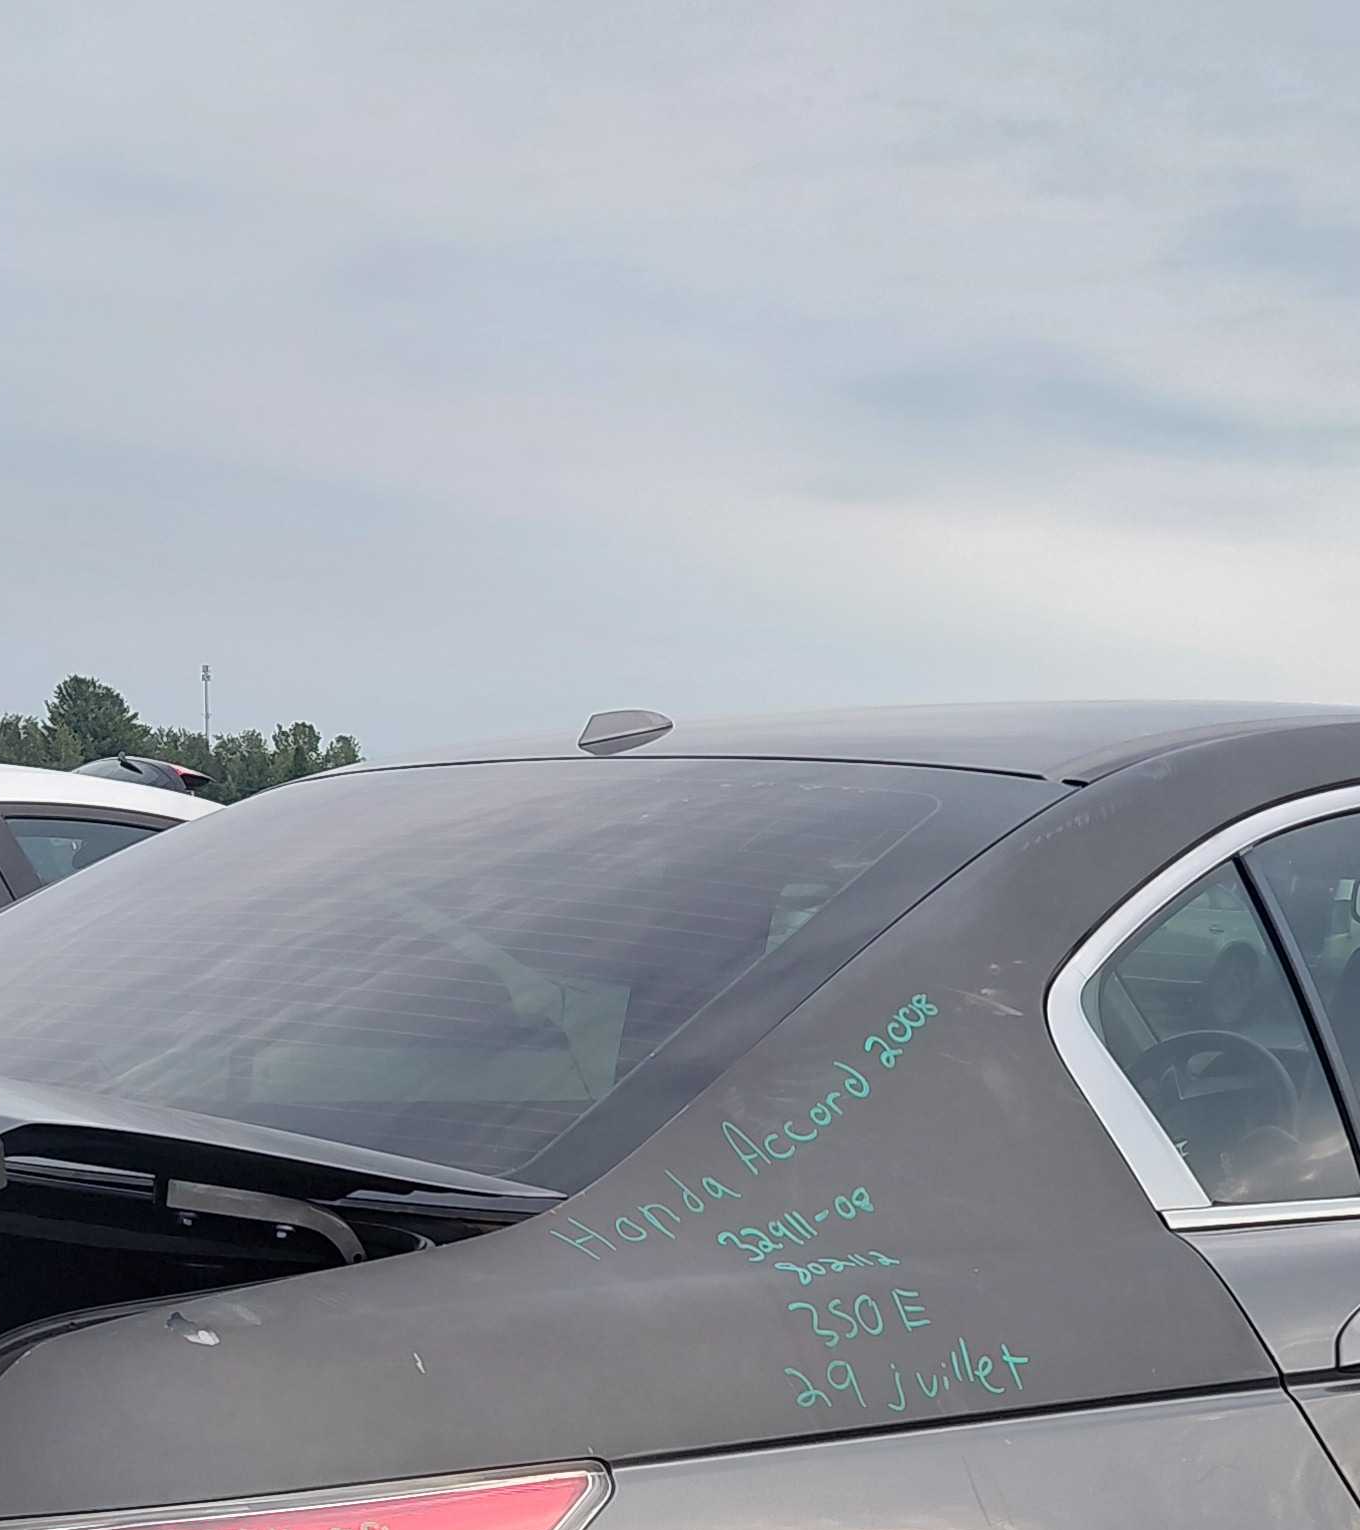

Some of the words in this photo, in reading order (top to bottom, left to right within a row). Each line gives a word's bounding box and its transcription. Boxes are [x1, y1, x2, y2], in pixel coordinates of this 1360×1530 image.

[550, 1169, 741, 1260] Honda
[722, 1060, 870, 1175] Accord
[864, 993, 938, 1069] 2008
[718, 1186, 874, 1262] 32911-08
[784, 1359, 867, 1408] 29
